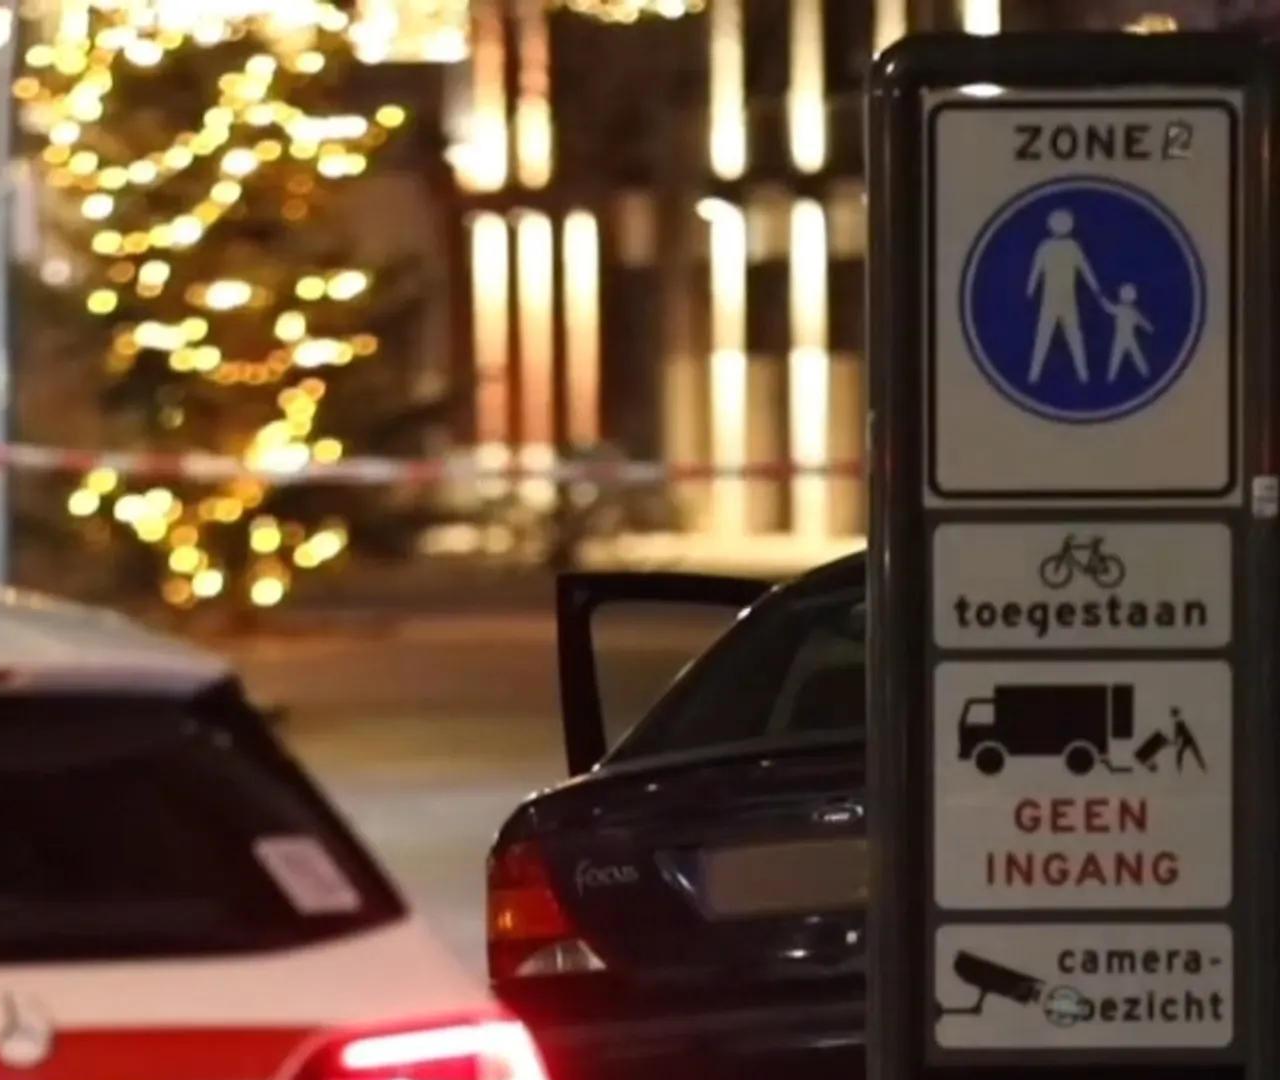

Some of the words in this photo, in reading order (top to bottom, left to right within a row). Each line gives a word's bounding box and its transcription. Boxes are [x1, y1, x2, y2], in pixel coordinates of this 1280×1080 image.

[1014, 123, 1152, 162] ZONE
[954, 594, 1208, 639] toegestaan
[1014, 797, 1148, 834] GEEN
[986, 850, 1179, 887] INGANG
[1057, 948, 1222, 975] camera-
[1062, 990, 1224, 1023] oezicht
